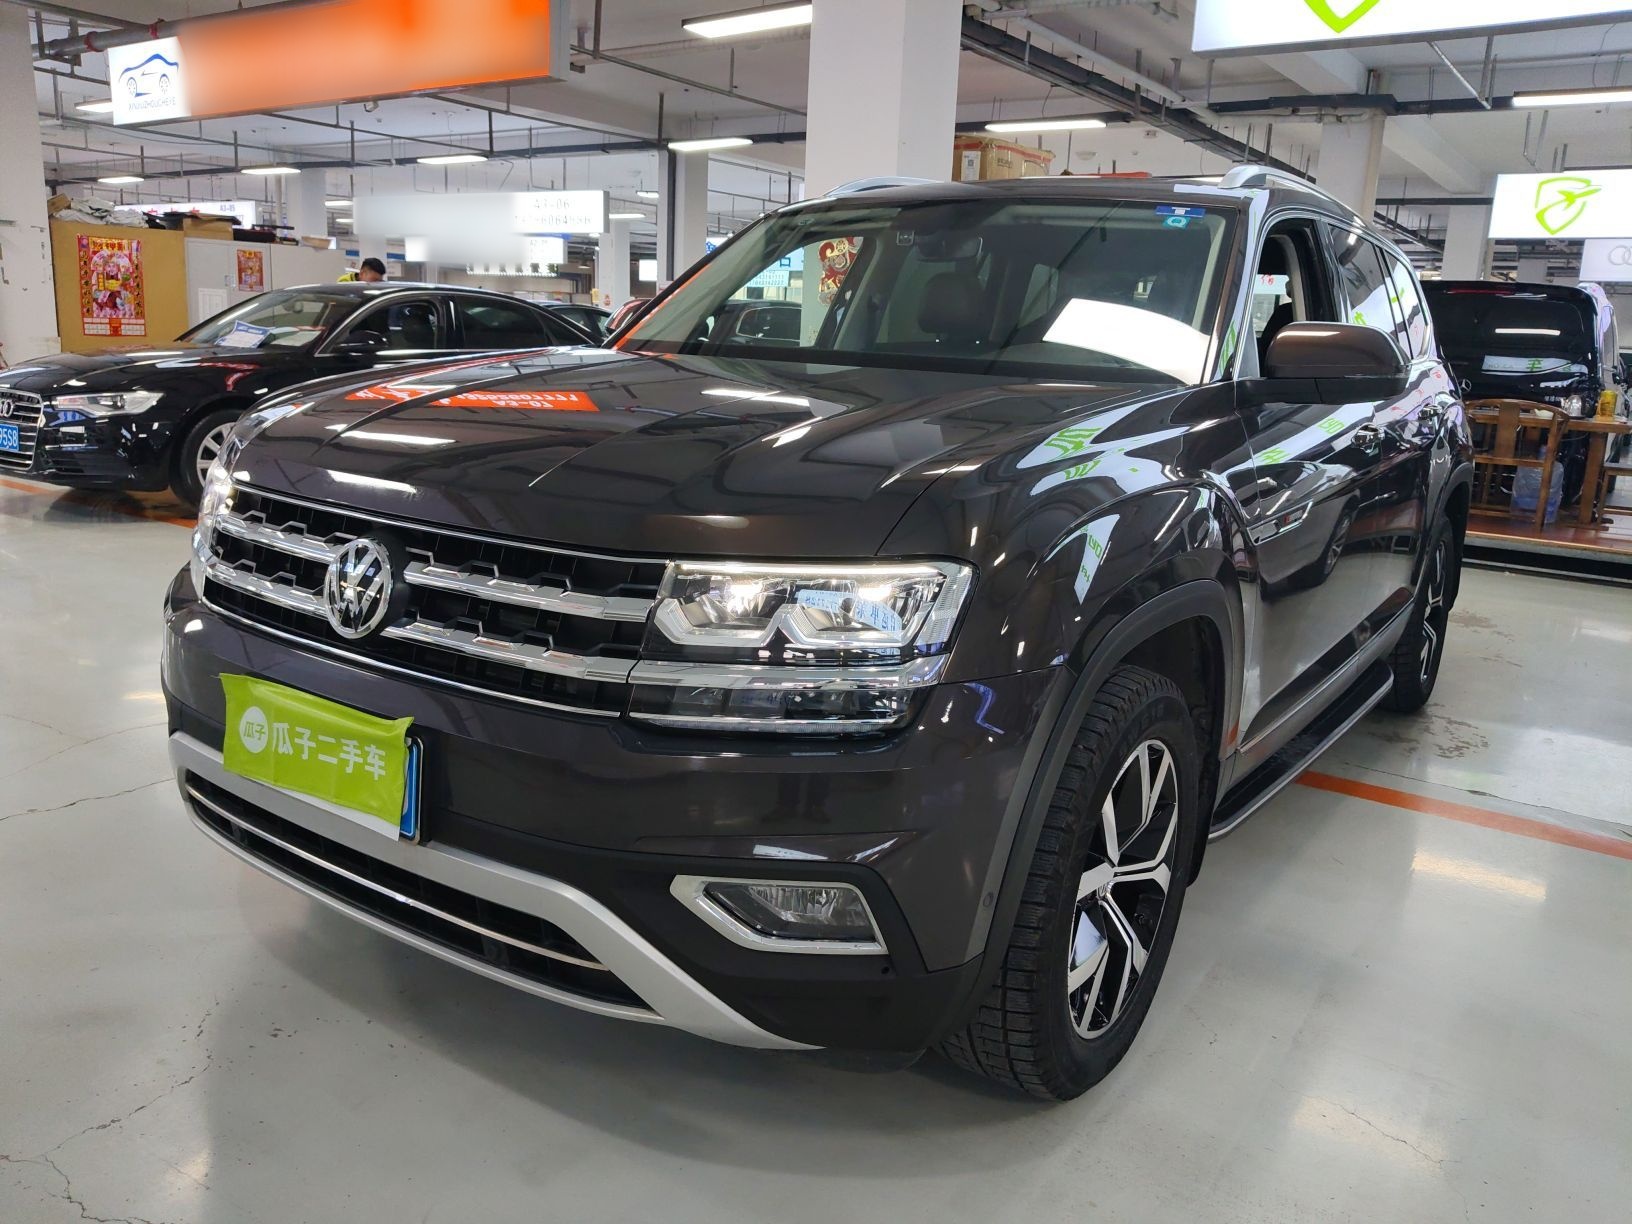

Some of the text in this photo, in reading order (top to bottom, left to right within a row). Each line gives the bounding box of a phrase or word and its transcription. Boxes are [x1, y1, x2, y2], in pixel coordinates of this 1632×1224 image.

[242, 720, 266, 740] 瓜子
[272, 722, 386, 781] 瓜子二手车
